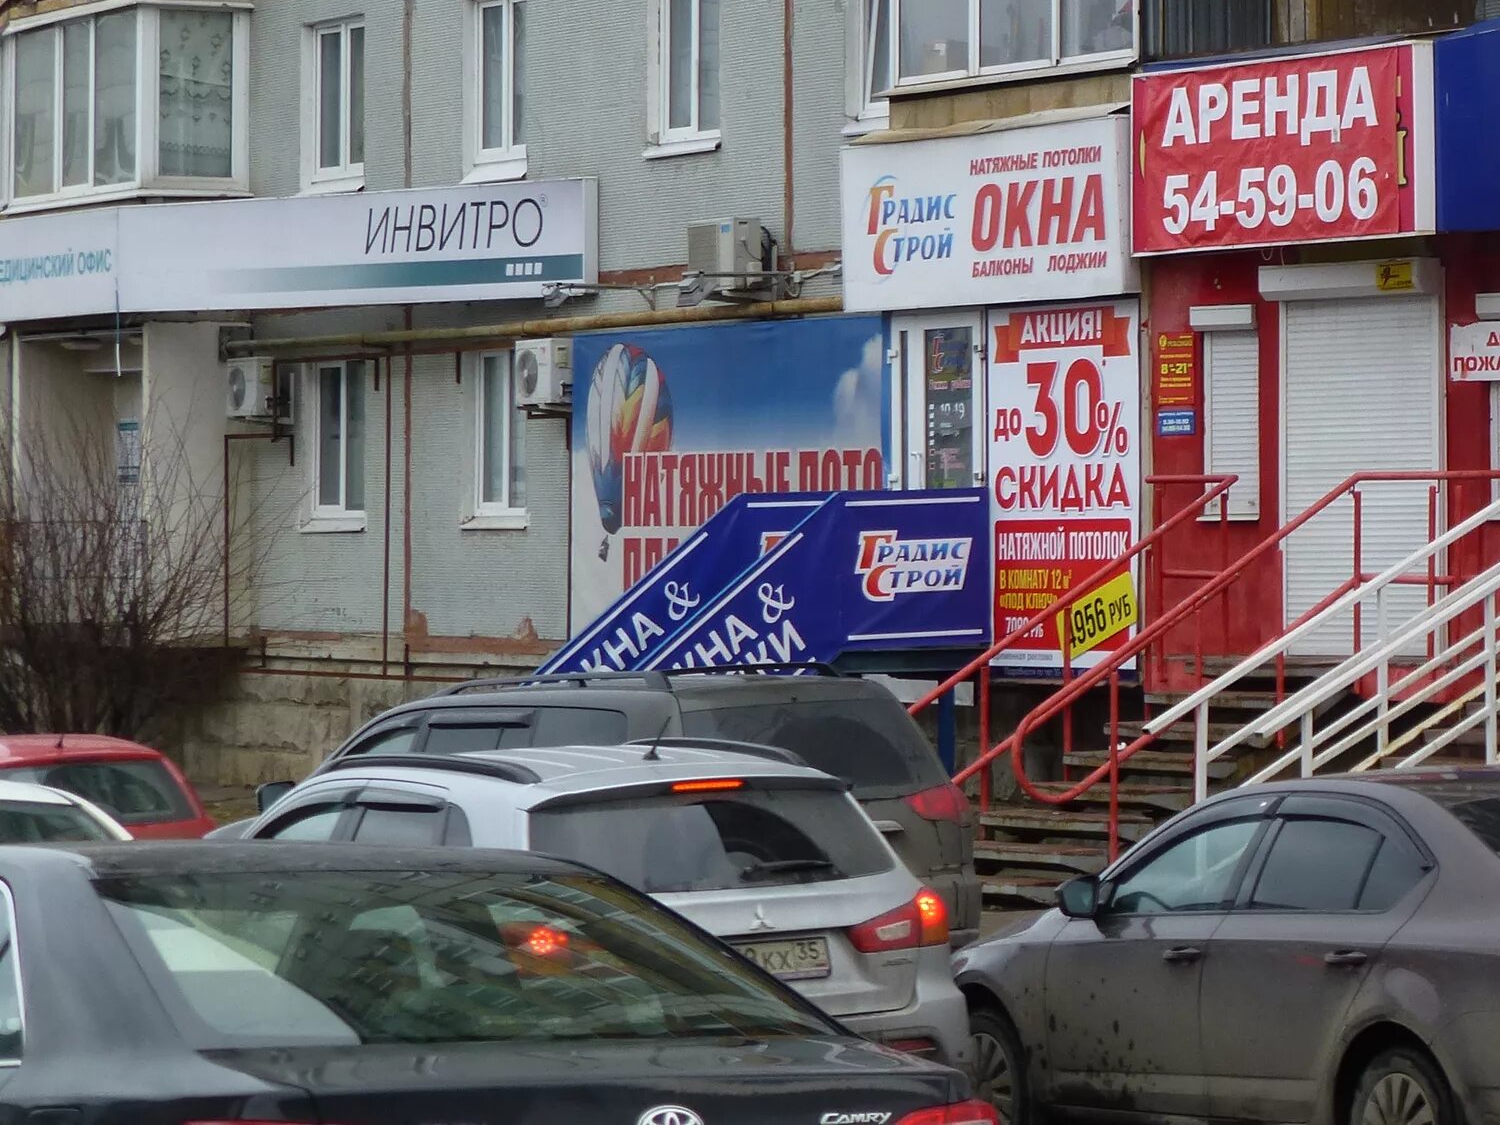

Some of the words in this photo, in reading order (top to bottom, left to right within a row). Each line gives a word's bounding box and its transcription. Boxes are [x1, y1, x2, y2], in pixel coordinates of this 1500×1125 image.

[1161, 66, 1379, 147] АРЕНДА
[970, 152, 1038, 176] НАТЯЖНЫЕ
[1043, 145, 1102, 167] ПОТОЛКИ
[1162, 156, 1378, 235] 54-59-06
[365, 198, 543, 254] ИНВИТРО
[971, 174, 1106, 252] ОКНА
[78, 248, 112, 275] ОФИС
[972, 257, 1034, 278] БАЛКОНЫ
[1047, 251, 1107, 274] ЛОДЖИИ
[1020, 310, 1103, 344] АКЦИЯ!
[994, 463, 1131, 515] СКИДКА
[999, 526, 1065, 561] НАТЯЖНОЙ
[1069, 531, 1129, 560] ПОТОЛОК
[1000, 570, 1006, 589] В
[1008, 569, 1049, 590] КОМНАТУ
[1051, 569, 1062, 589] 12
[664, 581, 700, 621] &
[758, 582, 795, 624] &
[1108, 594, 1131, 625] РУБ
[797, 941, 819, 960] 35
[820, 1112, 892, 1125] CAMRY
